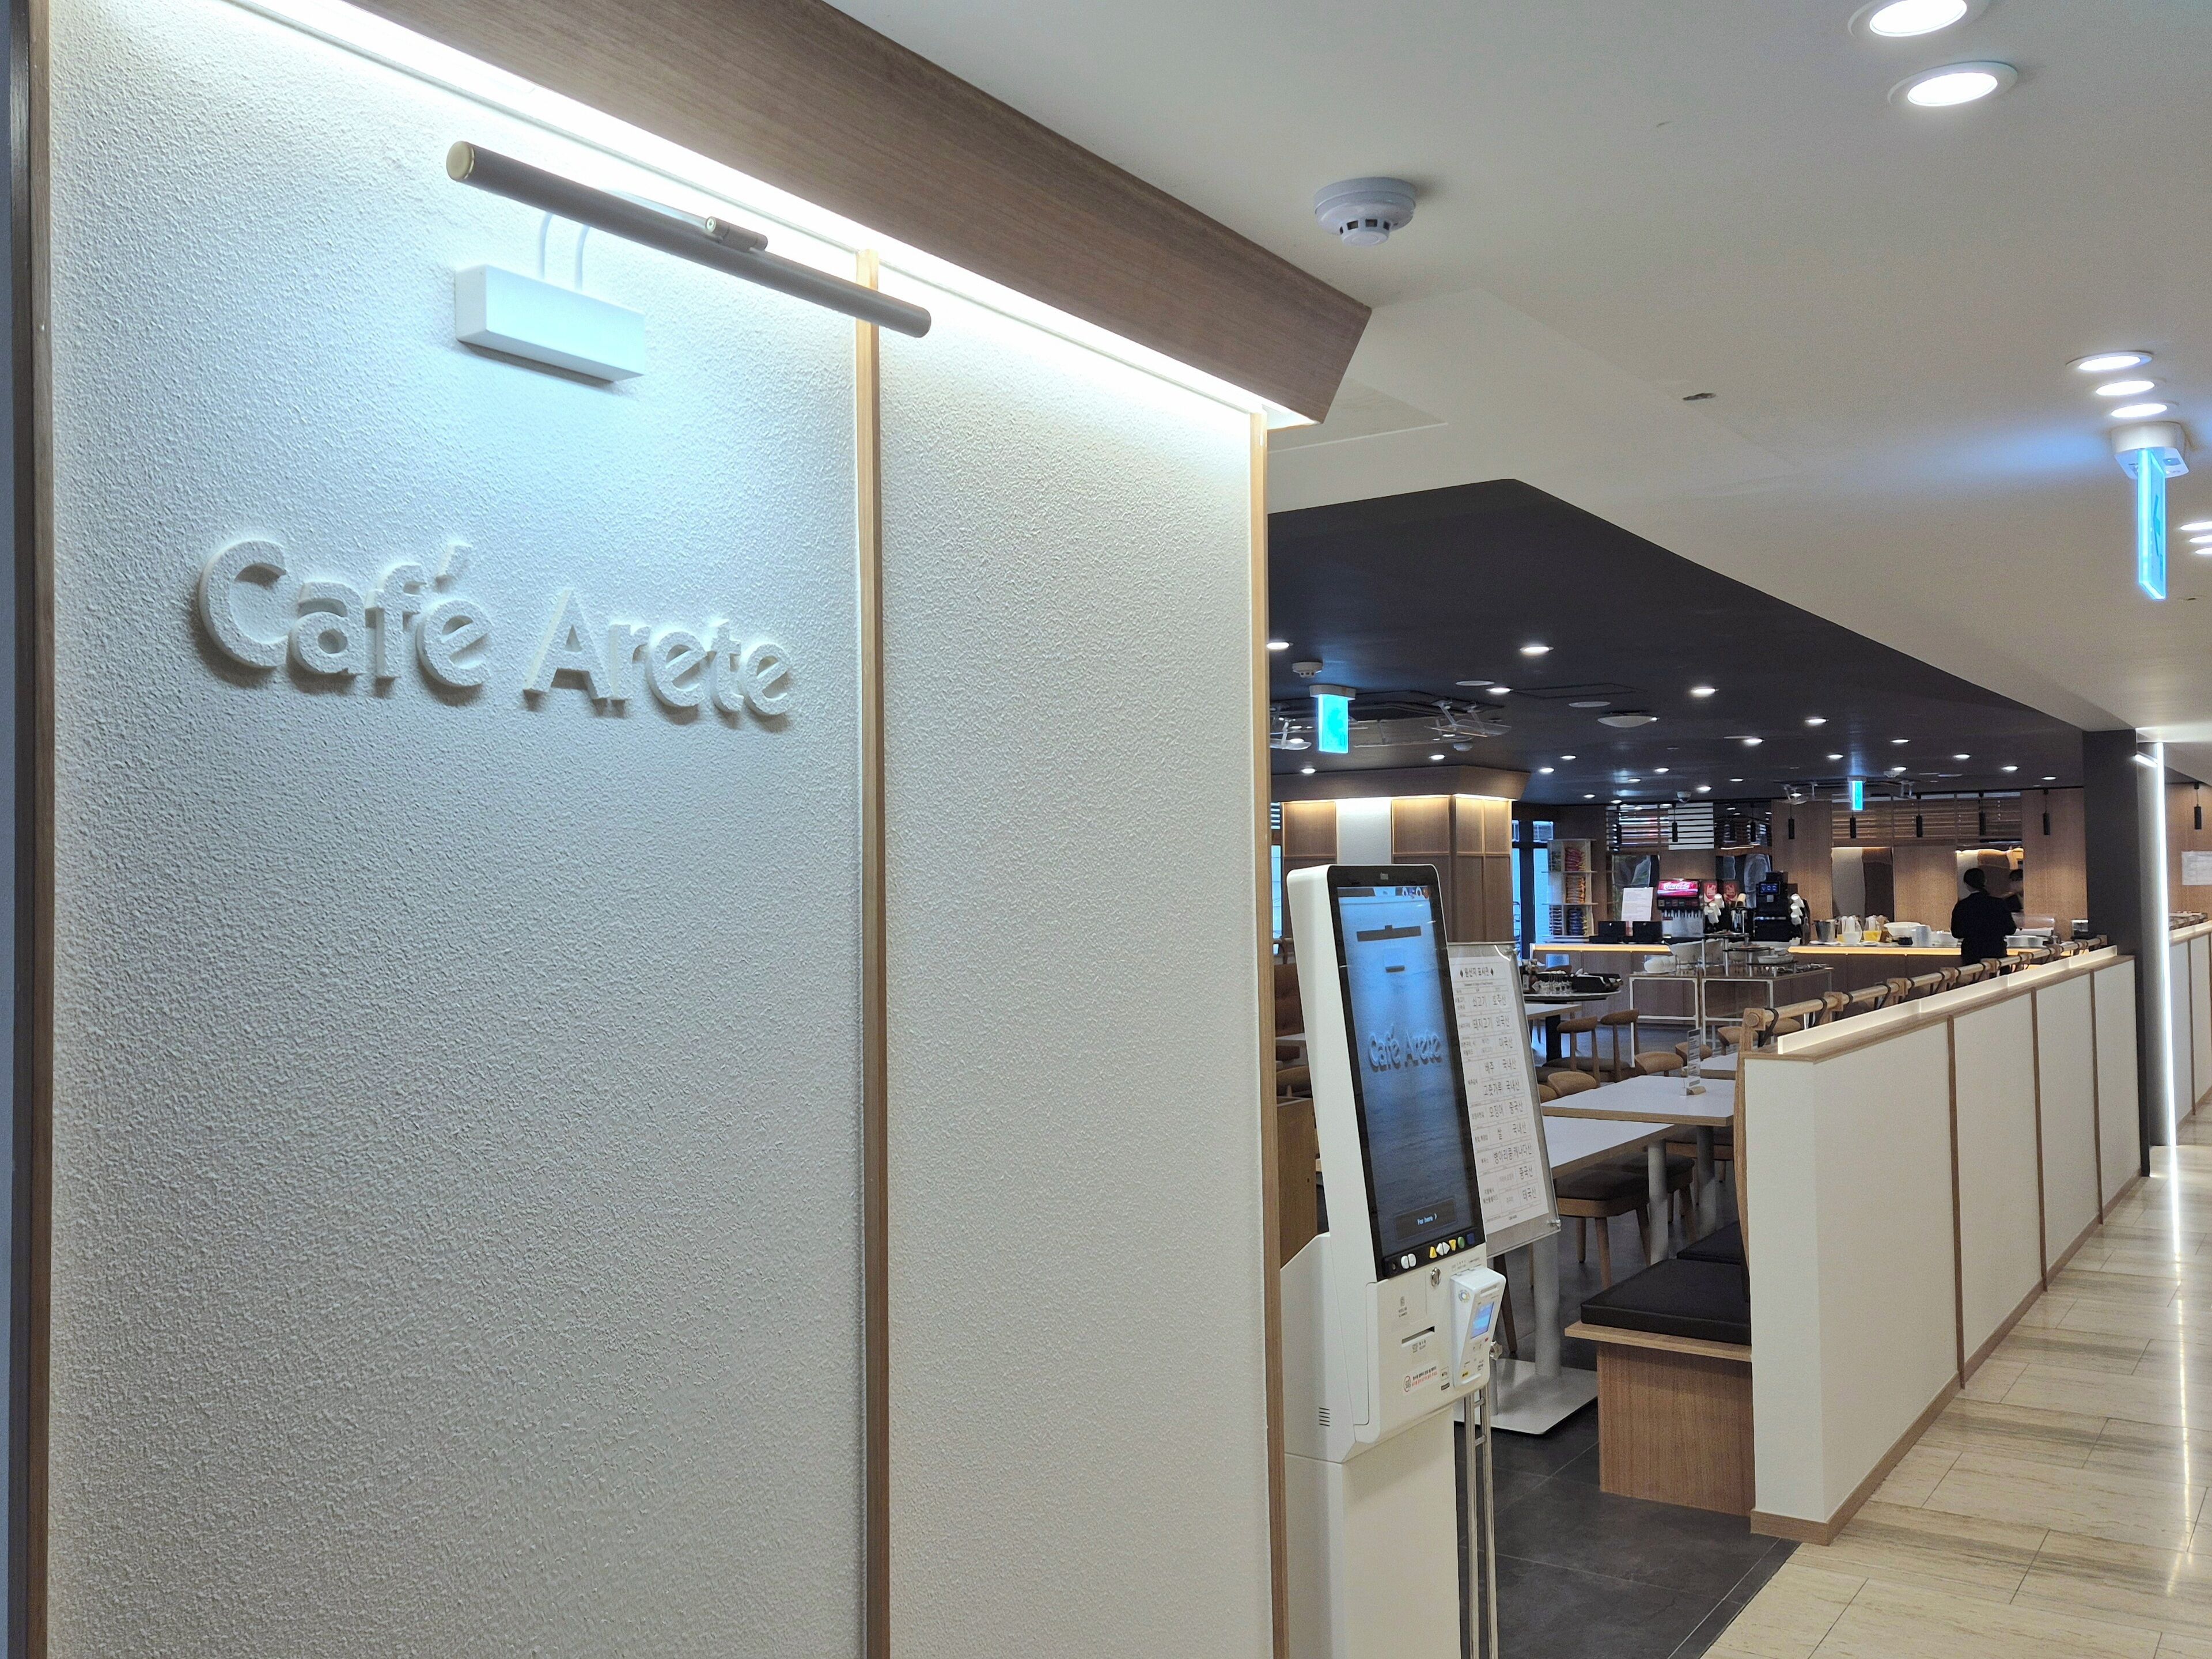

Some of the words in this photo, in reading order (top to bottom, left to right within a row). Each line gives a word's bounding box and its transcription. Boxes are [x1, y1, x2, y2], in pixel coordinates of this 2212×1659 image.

[199, 539, 495, 688] Café
[522, 589, 793, 717] Arete
[1492, 994, 1506, 1006] 호주산
[1472, 1017, 1493, 1030] 돼지고기
[1369, 1024, 1401, 1069] Café
[1502, 1058, 1516, 1071] 국내산
[1506, 1079, 1520, 1093] 국내산
[1489, 1103, 1504, 1118] 오징어
[1509, 1100, 1523, 1115] 중국산
[1512, 1121, 1527, 1135] 국내산
[1493, 1147, 1513, 1164] 병아리콩
[1513, 1142, 1532, 1158] 캐나다산
[1518, 1165, 1533, 1180] 중국산
